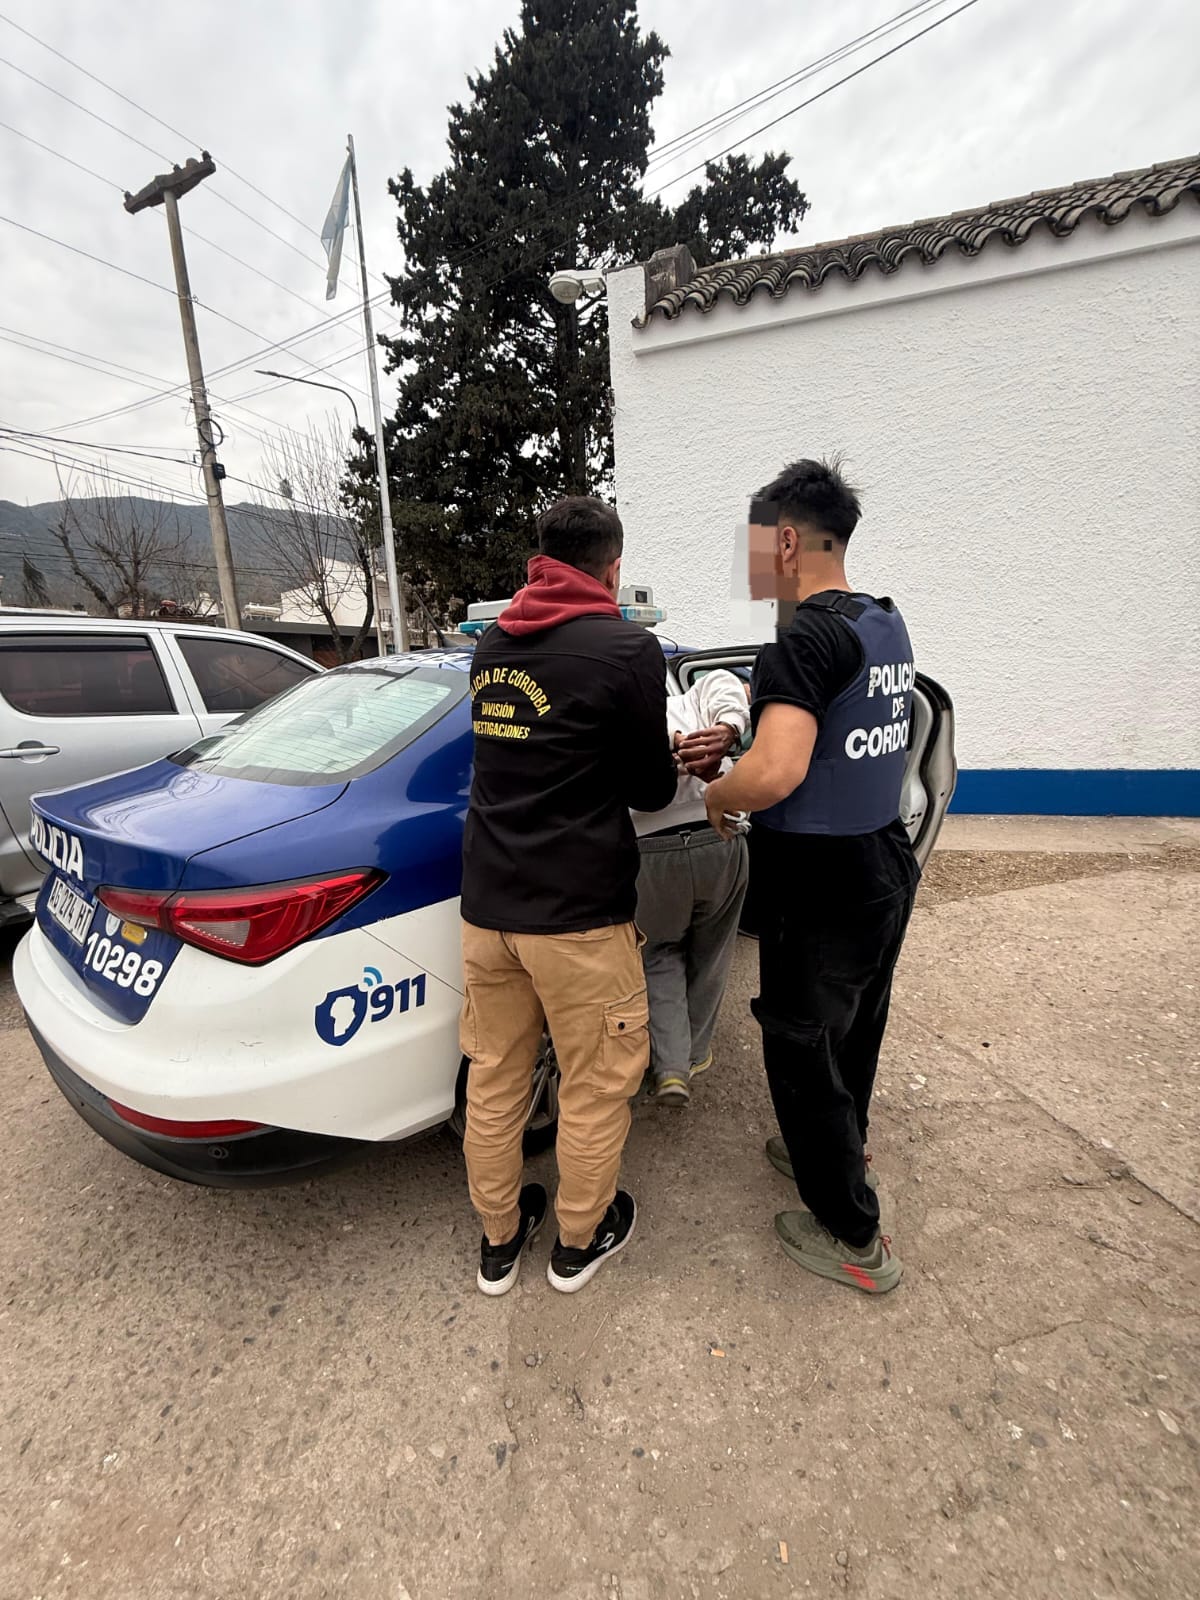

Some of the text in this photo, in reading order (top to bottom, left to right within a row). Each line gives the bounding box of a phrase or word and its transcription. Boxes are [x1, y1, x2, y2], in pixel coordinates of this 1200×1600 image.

[492, 667, 509, 684] DE
[507, 669, 551, 717] CÓRDOBA
[867, 662, 915, 698] POLICI
[481, 701, 516, 719] DIVISIÓN
[844, 718, 910, 760] CORDO
[84, 932, 163, 997] 10298
[370, 973, 426, 1023] 911
